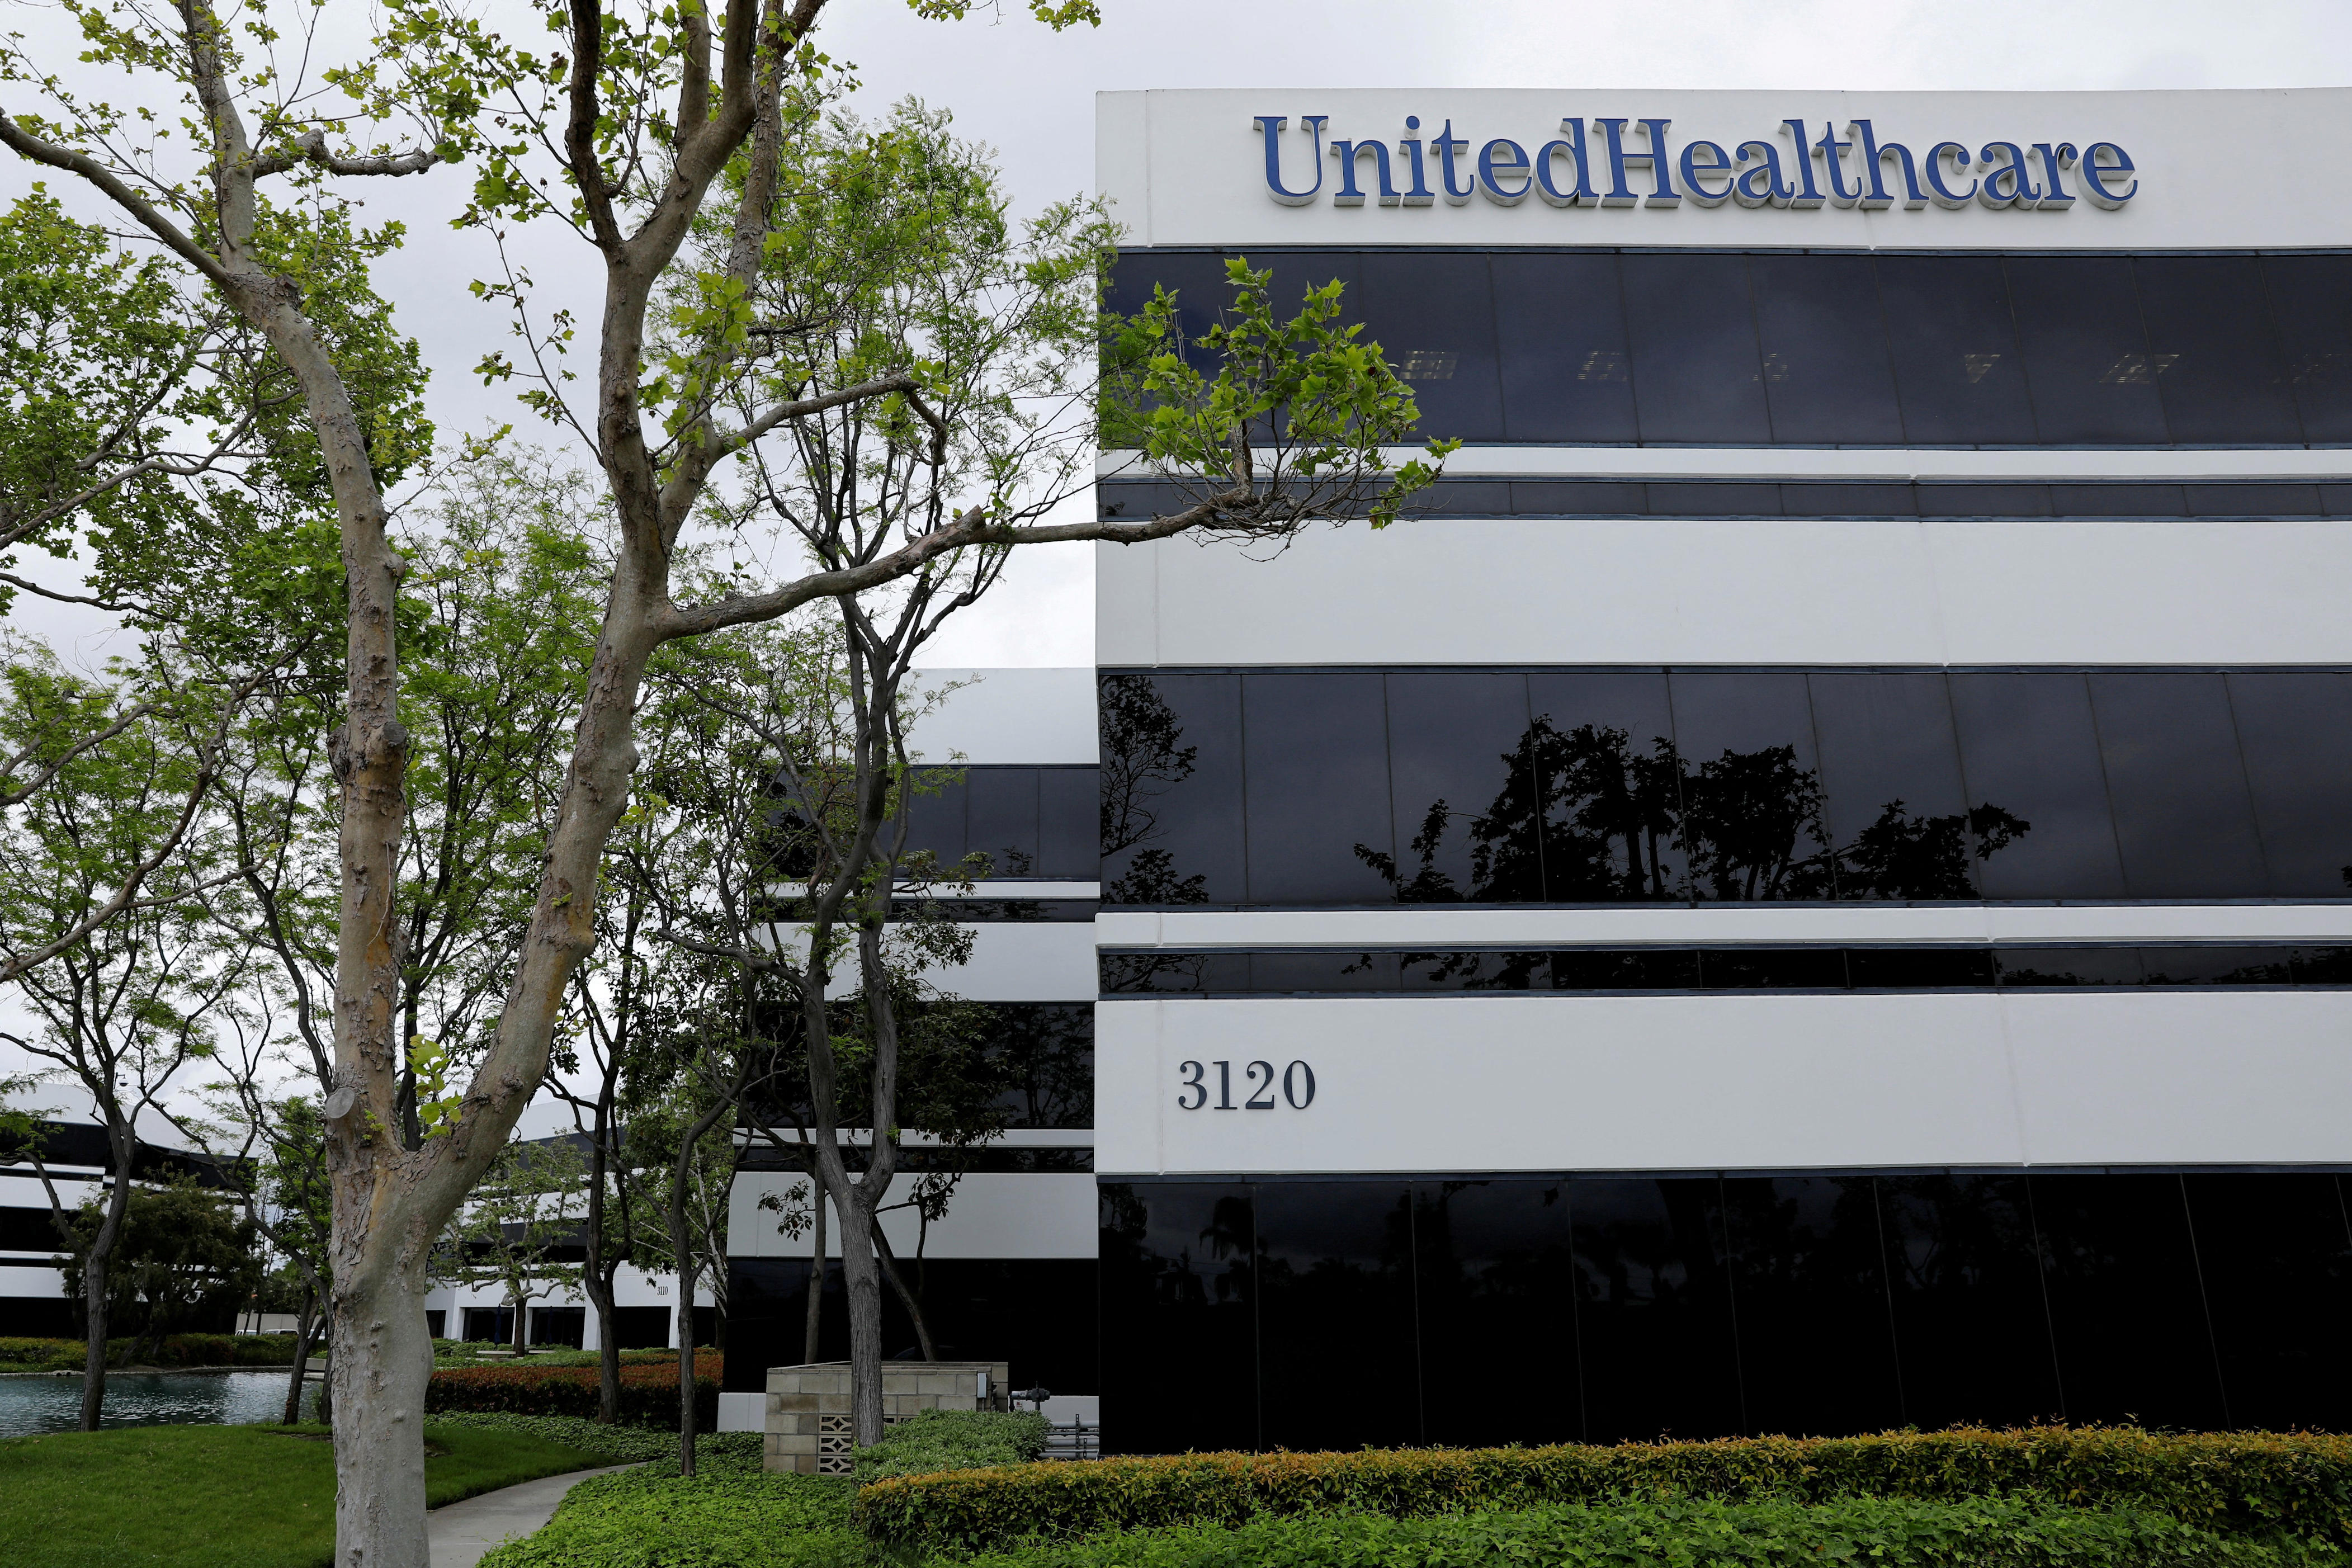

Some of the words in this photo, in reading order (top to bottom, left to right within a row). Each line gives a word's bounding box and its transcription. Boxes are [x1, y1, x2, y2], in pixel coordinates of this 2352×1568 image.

[1253, 115, 2138, 210] UnitedHealthcare
[1178, 1060, 1315, 1109] 3120
[657, 1286, 668, 1296] 3110
